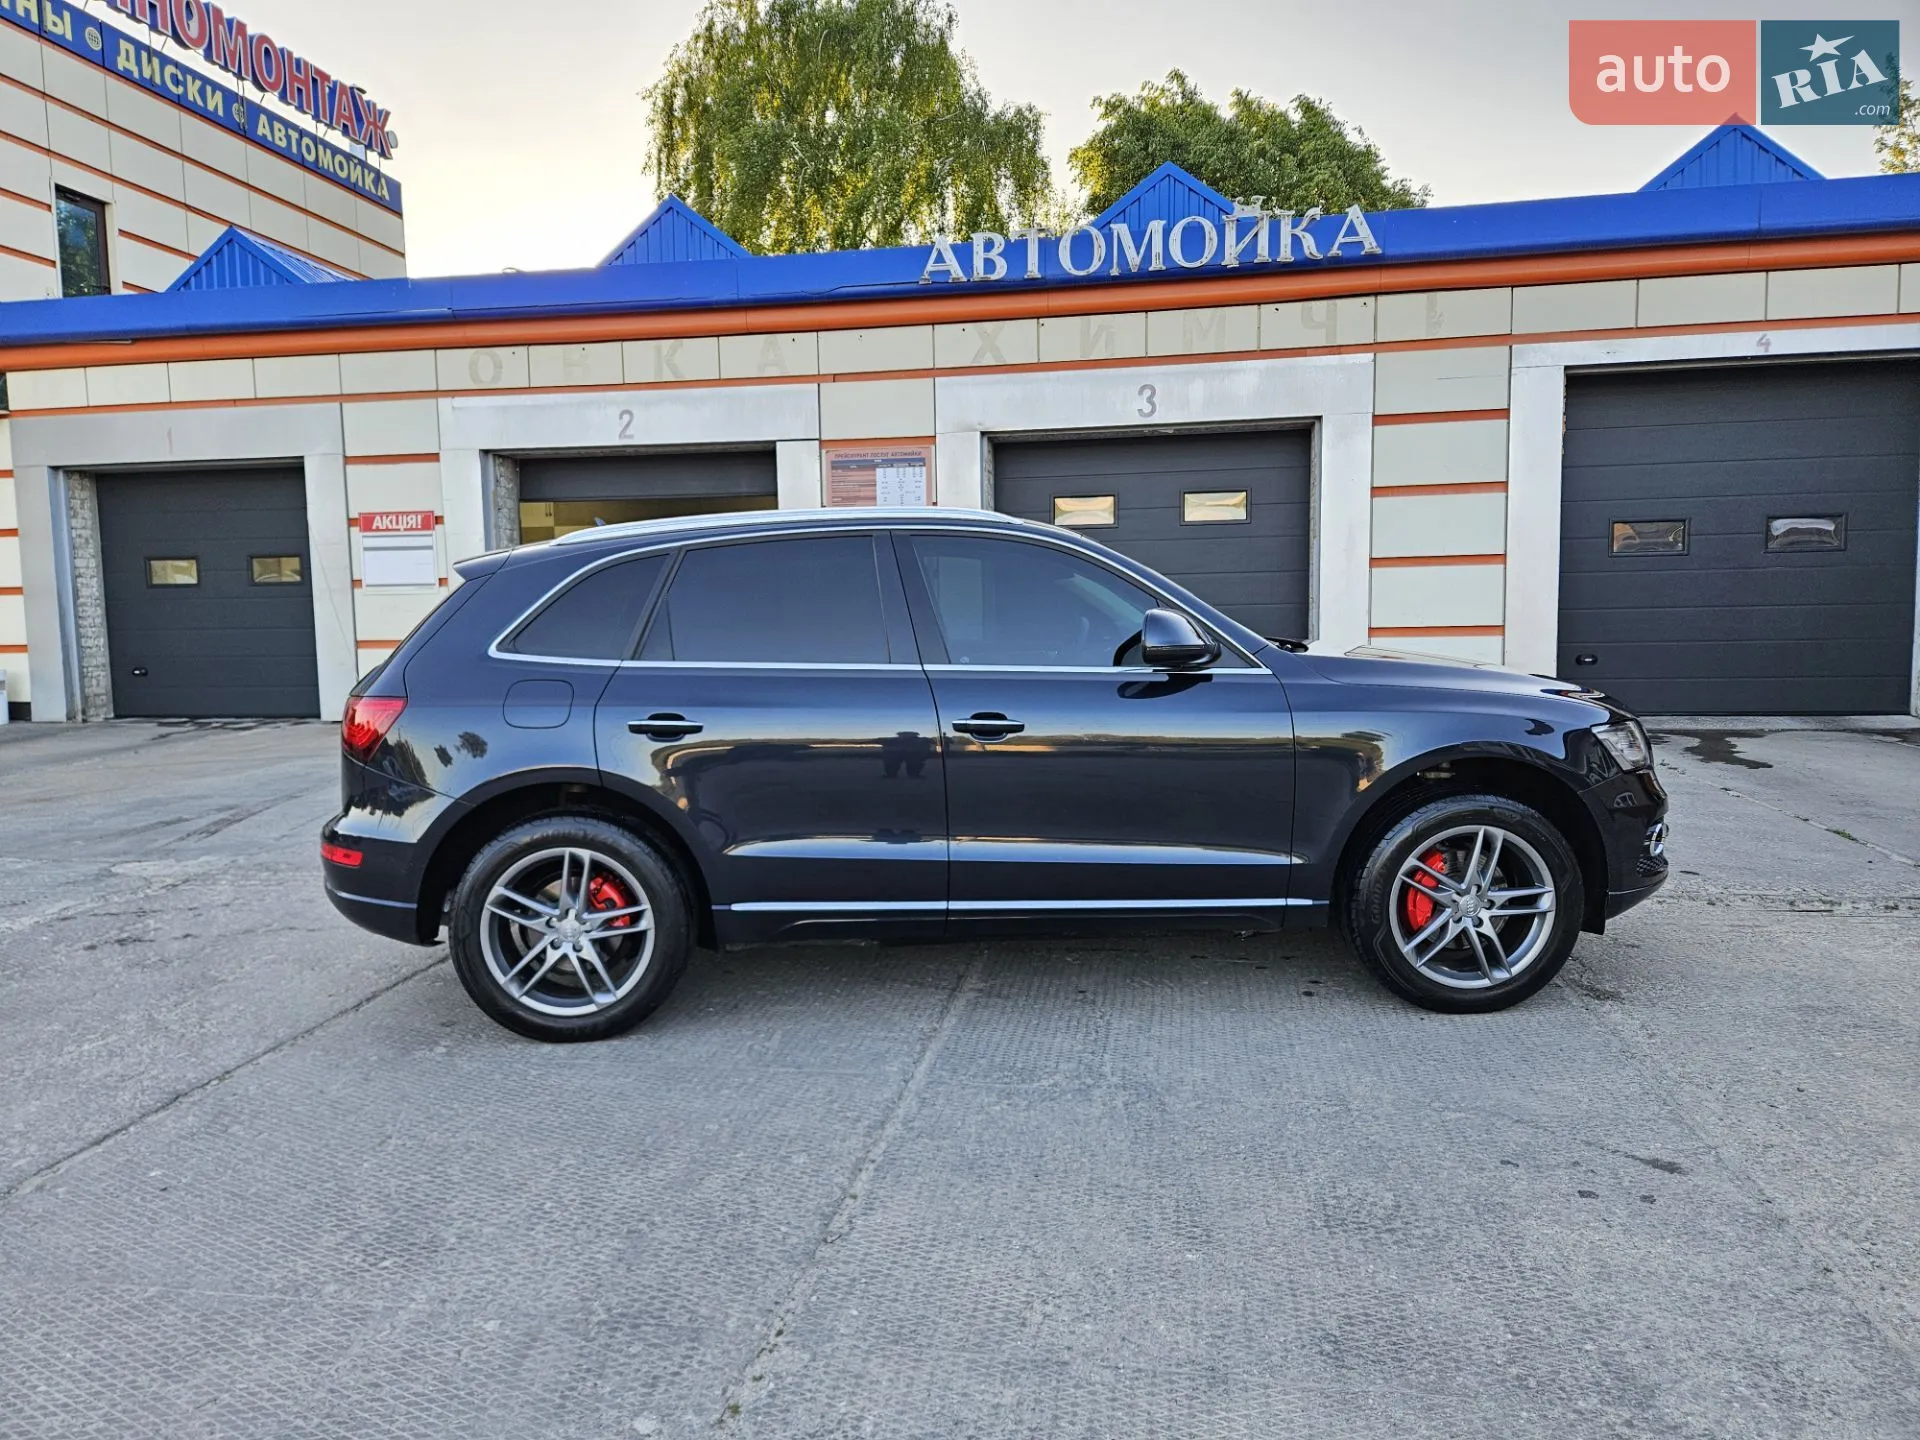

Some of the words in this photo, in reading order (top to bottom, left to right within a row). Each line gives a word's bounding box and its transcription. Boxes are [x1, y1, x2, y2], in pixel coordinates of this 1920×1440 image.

[108, 0, 393, 160] НОМОНТАЖ
[0, 0, 72, 41] НЫ
[117, 38, 223, 118] ДИСКИ
[256, 114, 390, 200] АВТОМОЙКА
[919, 196, 1382, 284] АВТОМОЙКА
[1755, 334, 1772, 353] 4
[1137, 384, 1158, 418] 3
[618, 409, 635, 440] 2
[372, 514, 422, 532] АКЦІЯ!
